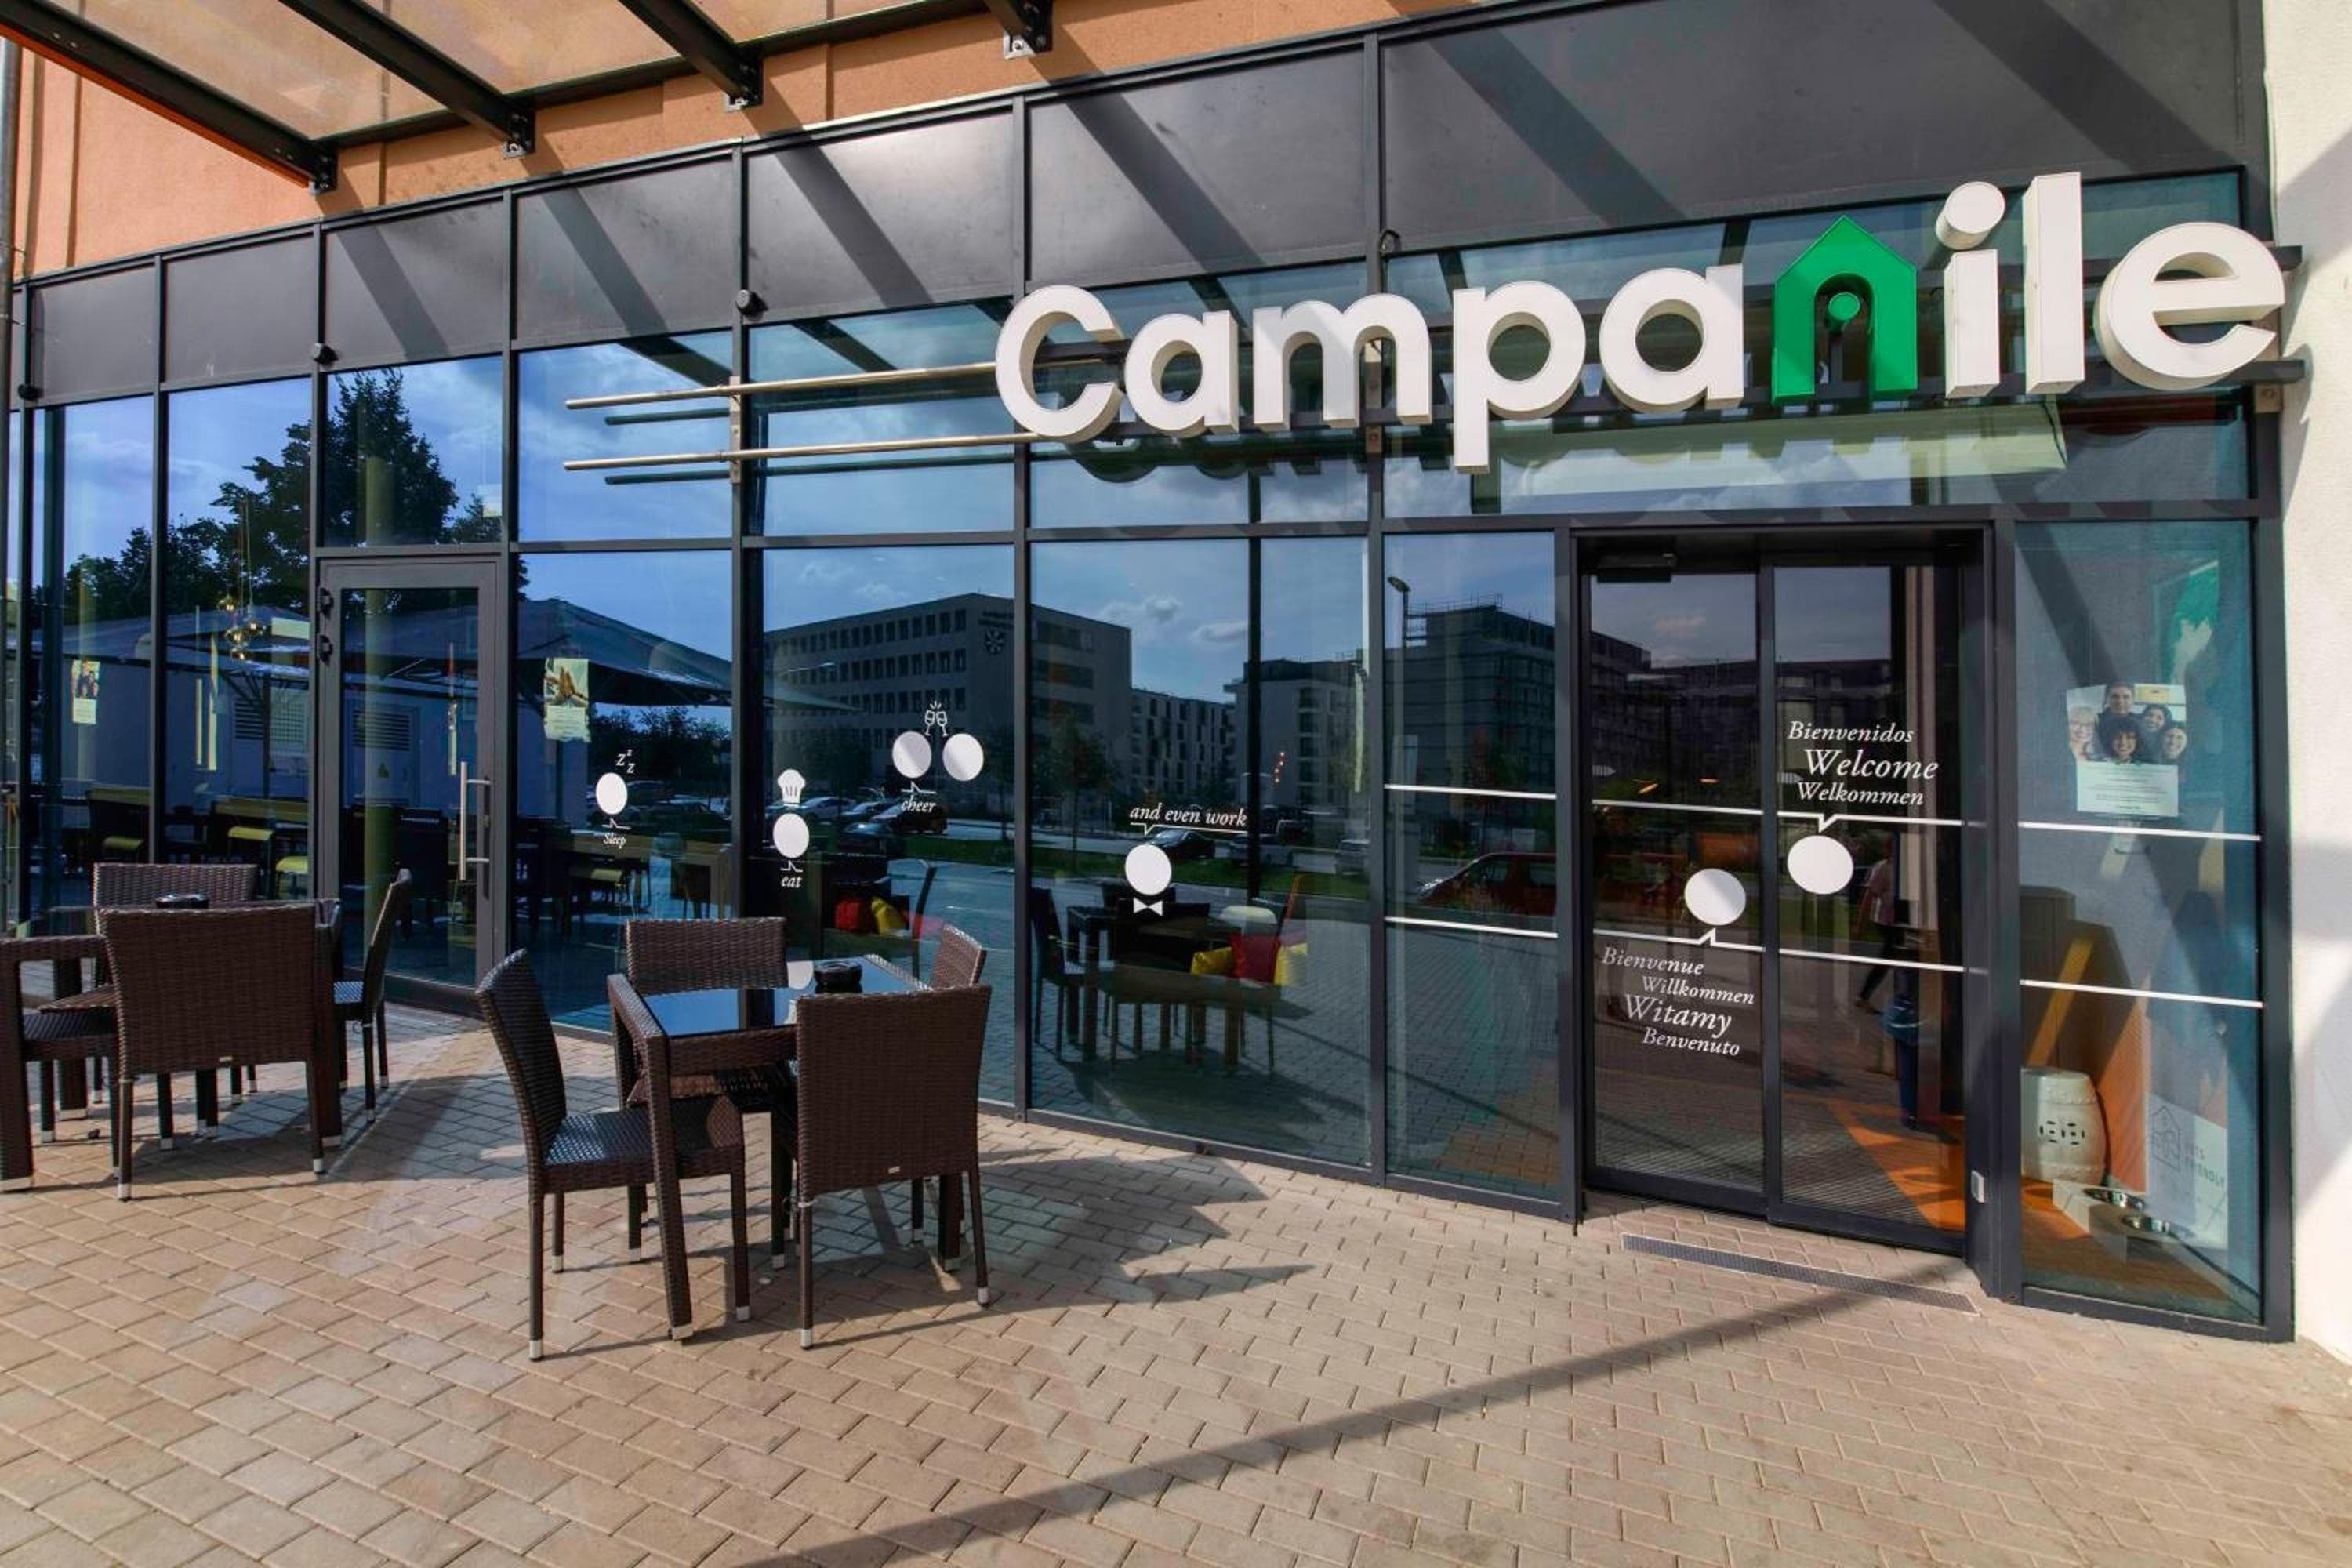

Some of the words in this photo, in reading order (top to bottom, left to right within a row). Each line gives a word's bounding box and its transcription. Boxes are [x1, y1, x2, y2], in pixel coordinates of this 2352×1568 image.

[1787, 720, 1915, 743] Bienvenidos
[1804, 748, 1940, 780] Welcome
[902, 794, 937, 813] cheer
[1797, 782, 1924, 806] Welkommen
[1129, 802, 1163, 820] and
[1165, 809, 1201, 823] even
[1205, 808, 1248, 826] work
[781, 875, 803, 888] eat
[1602, 946, 1705, 975] Bienvenue
[1642, 976, 1755, 1004] Willkommen
[1624, 994, 1733, 1039] Witamy
[1642, 1026, 1740, 1056] Benvenuto
